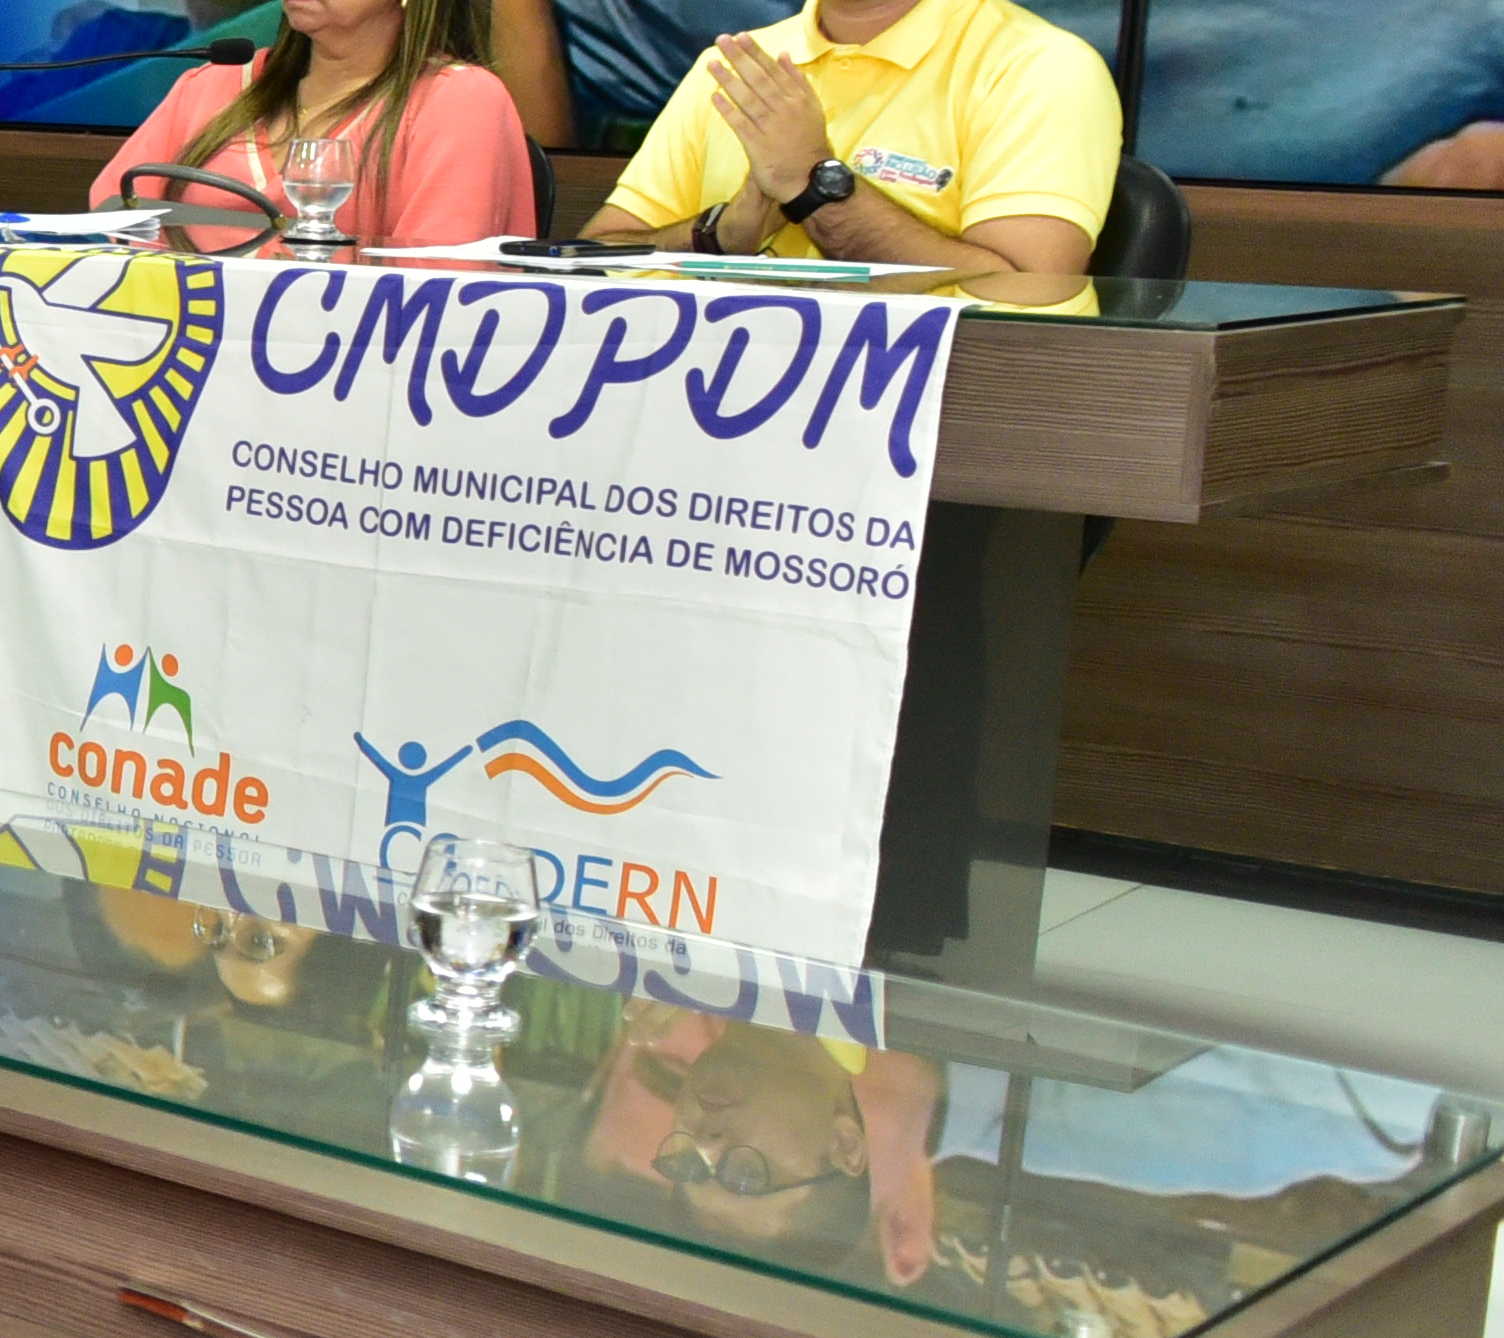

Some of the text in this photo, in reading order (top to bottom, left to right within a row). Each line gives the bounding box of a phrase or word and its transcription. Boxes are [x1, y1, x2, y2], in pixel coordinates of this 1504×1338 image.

[251, 266, 953, 478] CMDPDM
[225, 484, 911, 601] PESSOA COM DEFICIÊNCIA DE MOSSORÓ
[231, 439, 916, 552] CONSELHO MUNICIPAL DOS DIREITOS DA
[48, 731, 270, 825] conade
[553, 915, 587, 937] dos
[592, 920, 659, 950] Direitos
[664, 933, 687, 954] da
